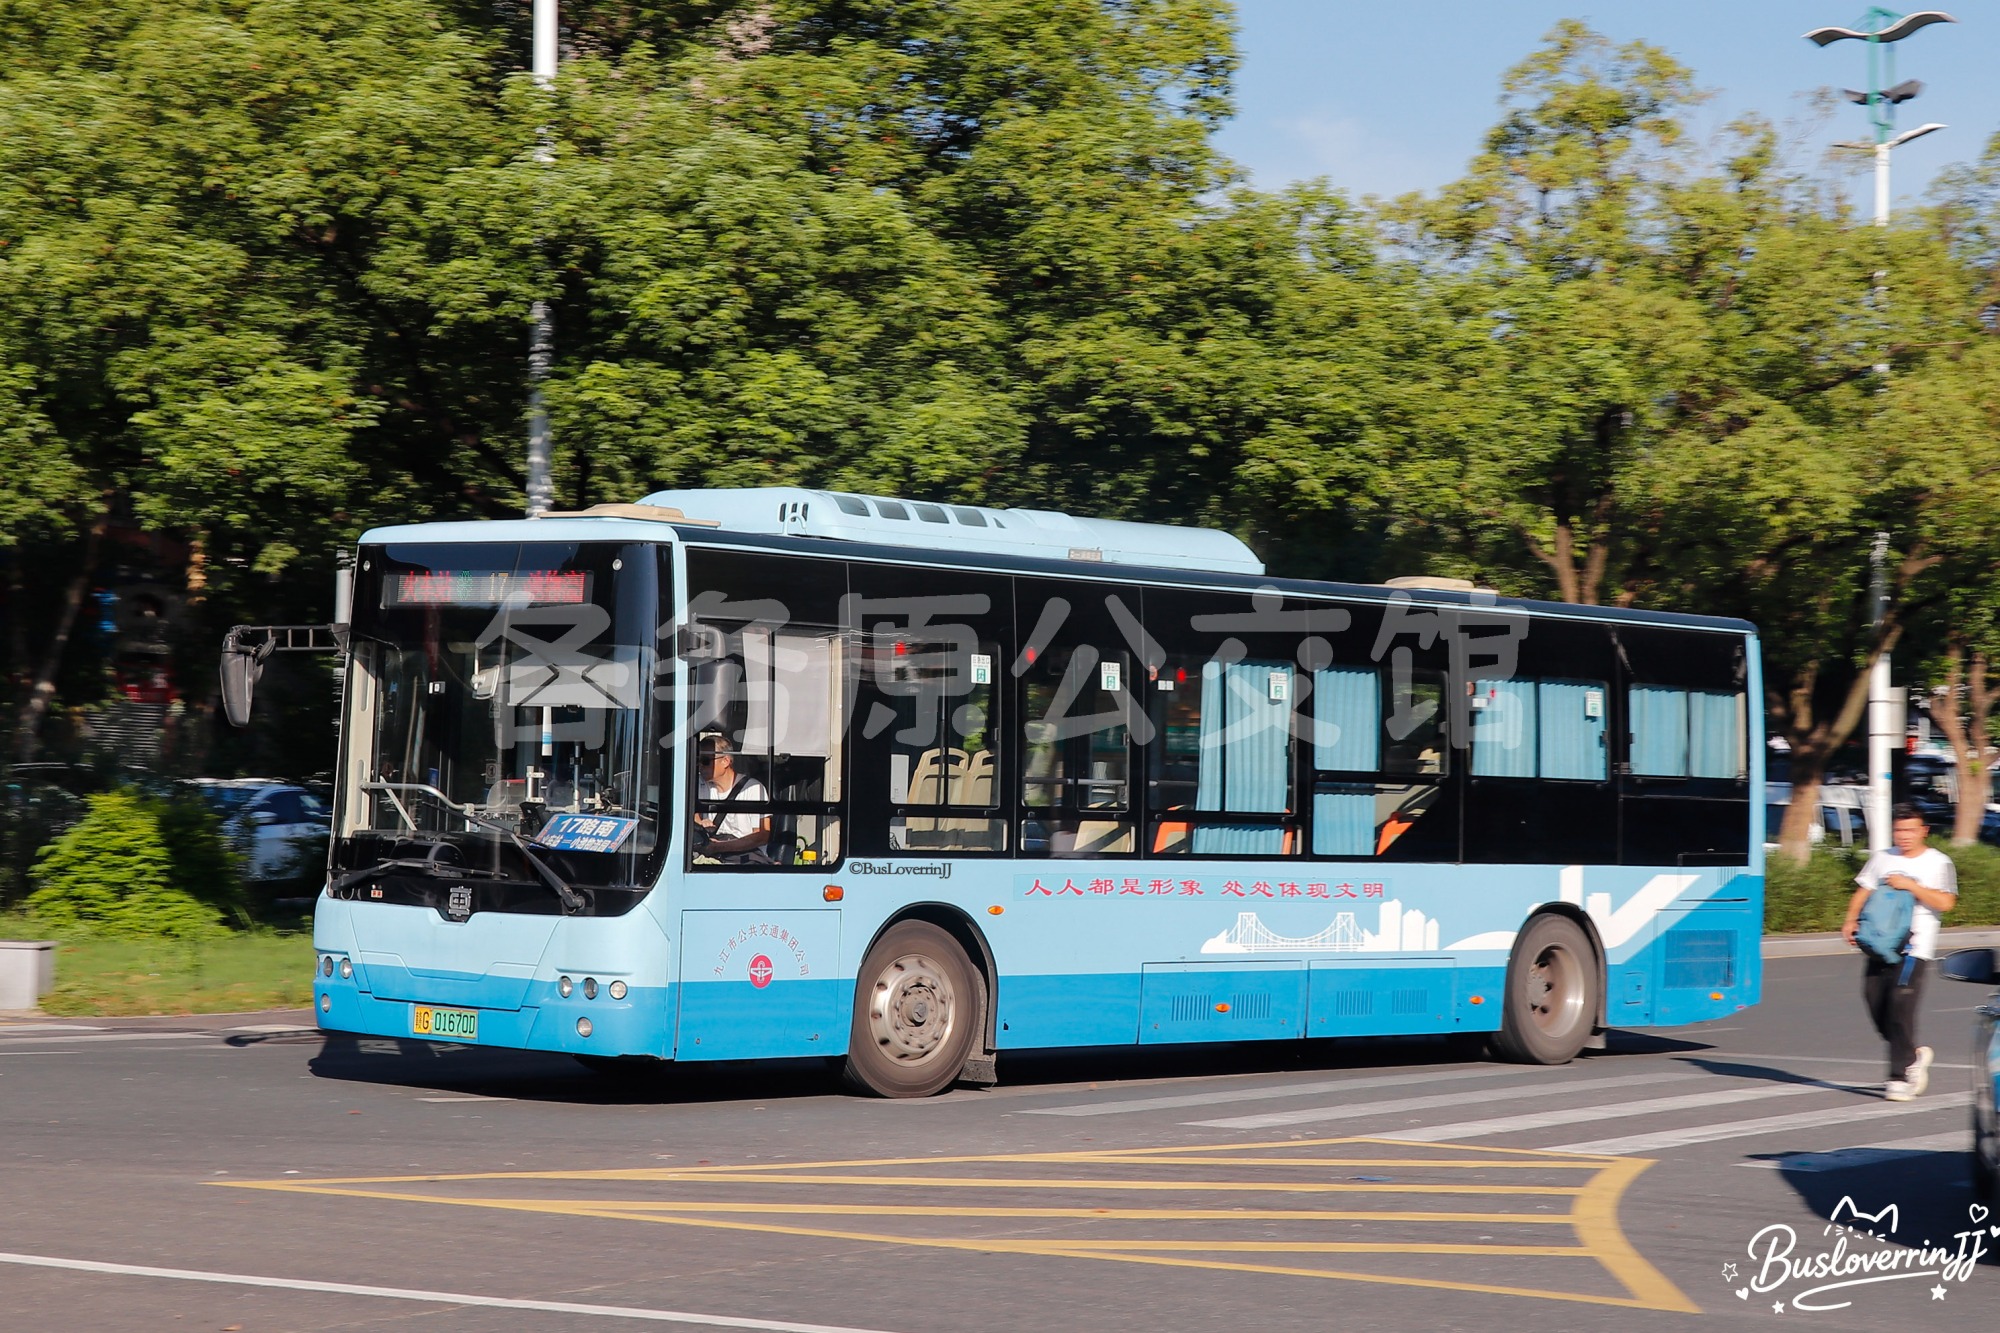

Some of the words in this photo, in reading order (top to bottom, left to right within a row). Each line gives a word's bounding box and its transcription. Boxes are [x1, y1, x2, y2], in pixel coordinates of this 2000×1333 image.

[488, 572, 509, 601] 17
[1024, 877, 1205, 897] 人人都是形象
[1220, 879, 1385, 899] 处处体现文明
[713, 922, 810, 979] 九江市公共交通集团公司
